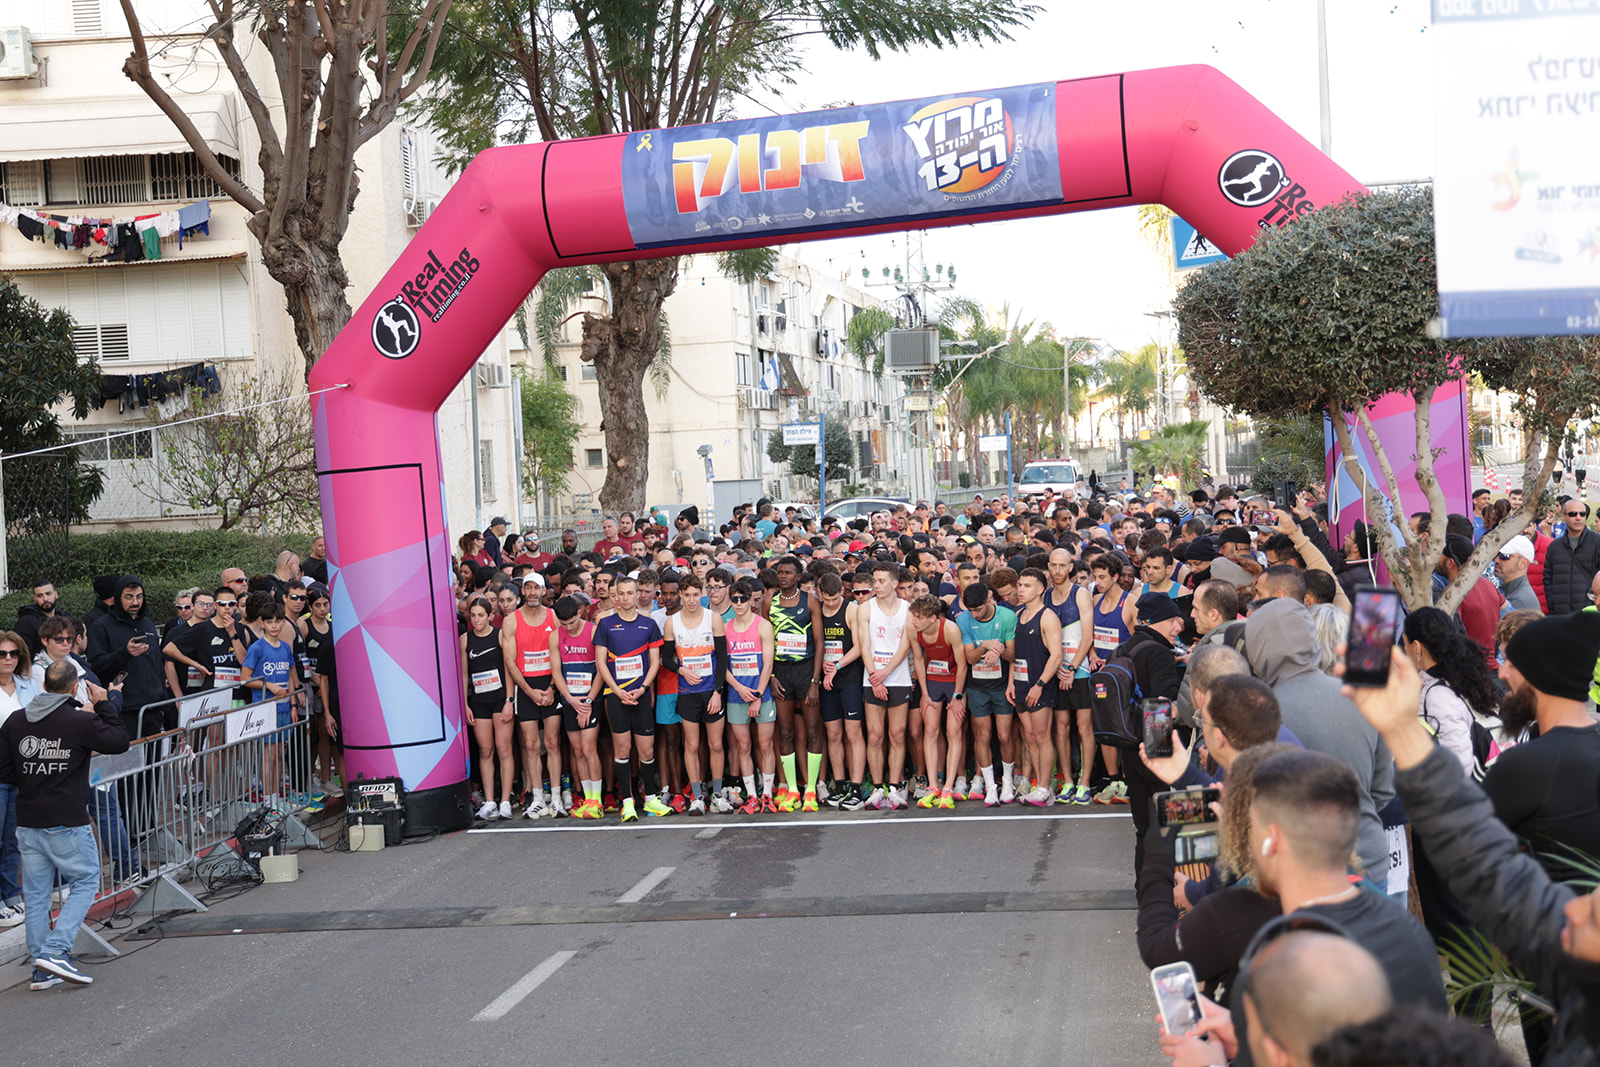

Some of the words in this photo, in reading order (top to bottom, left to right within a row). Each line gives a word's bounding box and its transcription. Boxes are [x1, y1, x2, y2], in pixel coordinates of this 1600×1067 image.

[903, 98, 1003, 159] מרוץ
[979, 121, 1004, 137] אור
[935, 132, 974, 156] יהודה
[1015, 134, 1023, 153] רצים
[672, 120, 870, 214] זינוק
[1010, 154, 1020, 167] יחד
[1000, 168, 1014, 186] למען
[977, 183, 1002, 199] החזרת
[1279, 183, 1315, 216] Re
[401, 249, 443, 305] Real
[413, 247, 480, 318] Timing
[433, 272, 472, 322] realtiming.co.il
[824, 627, 845, 636] LEADER
[40, 738, 61, 748] Real
[39, 747, 71, 759] Timing
[23, 762, 69, 775] STAFF
